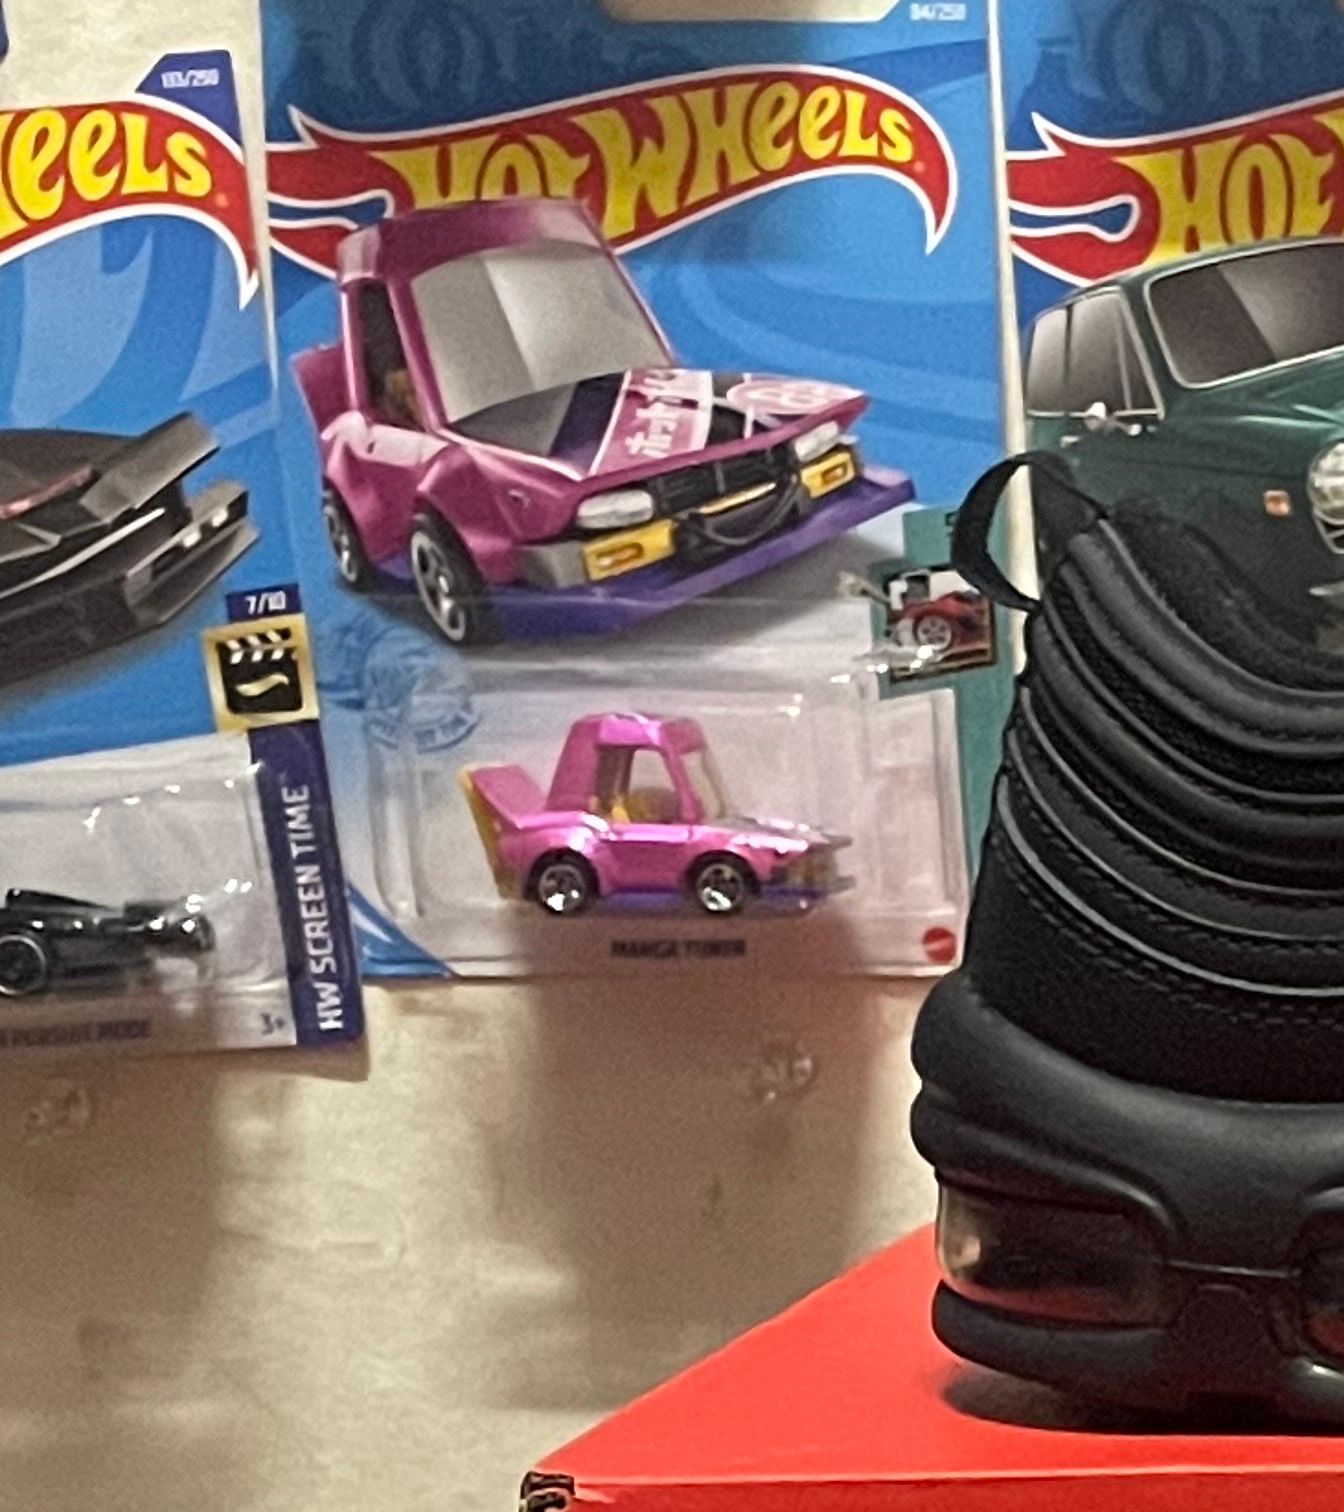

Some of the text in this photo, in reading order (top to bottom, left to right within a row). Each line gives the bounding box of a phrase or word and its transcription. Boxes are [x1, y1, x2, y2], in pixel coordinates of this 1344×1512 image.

[284, 783, 345, 1031] HW SCREEN TIME
